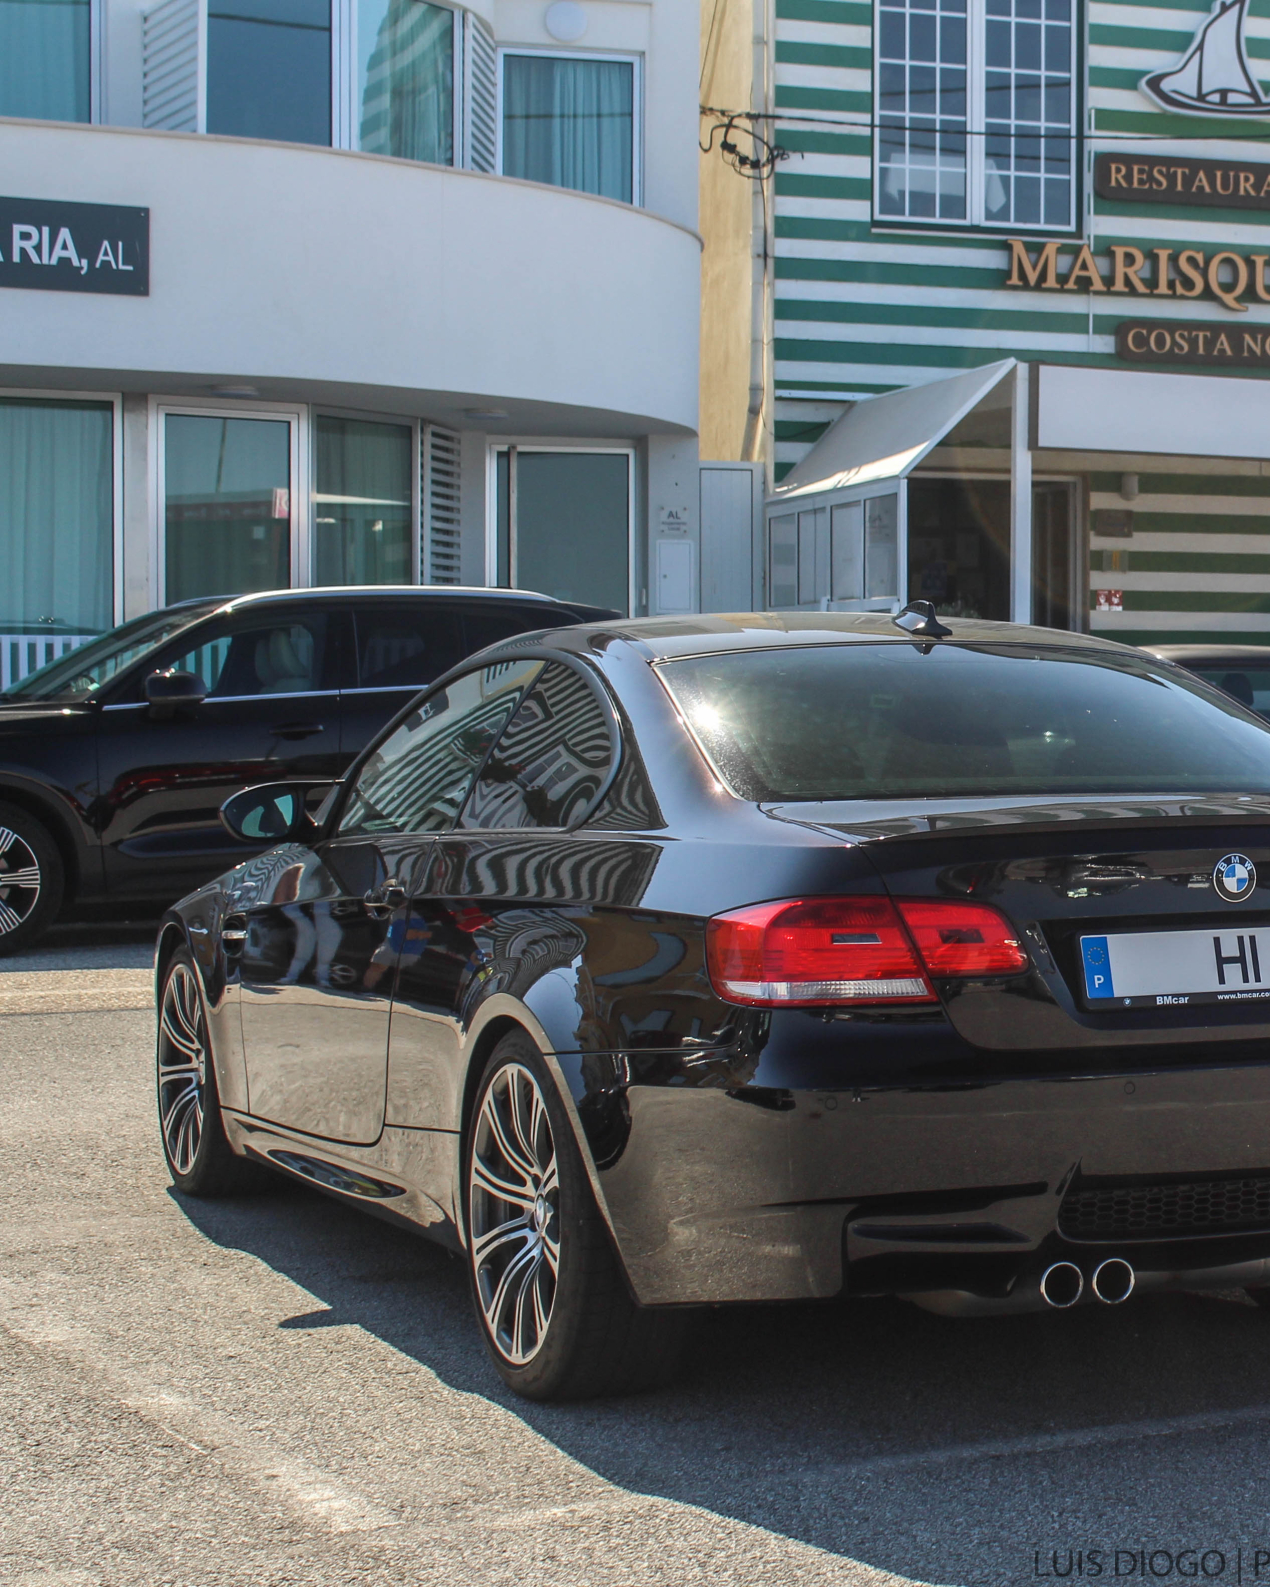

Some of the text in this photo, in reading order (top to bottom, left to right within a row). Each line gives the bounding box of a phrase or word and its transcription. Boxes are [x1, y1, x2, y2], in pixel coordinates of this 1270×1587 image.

[12, 222, 134, 275] RIA, AL
[1126, 327, 1234, 357] COSTA
[667, 510, 681, 520] AL
[1212, 934, 1262, 986] HI
[1093, 975, 1105, 988] P
[1156, 995, 1190, 1006] BMcar
